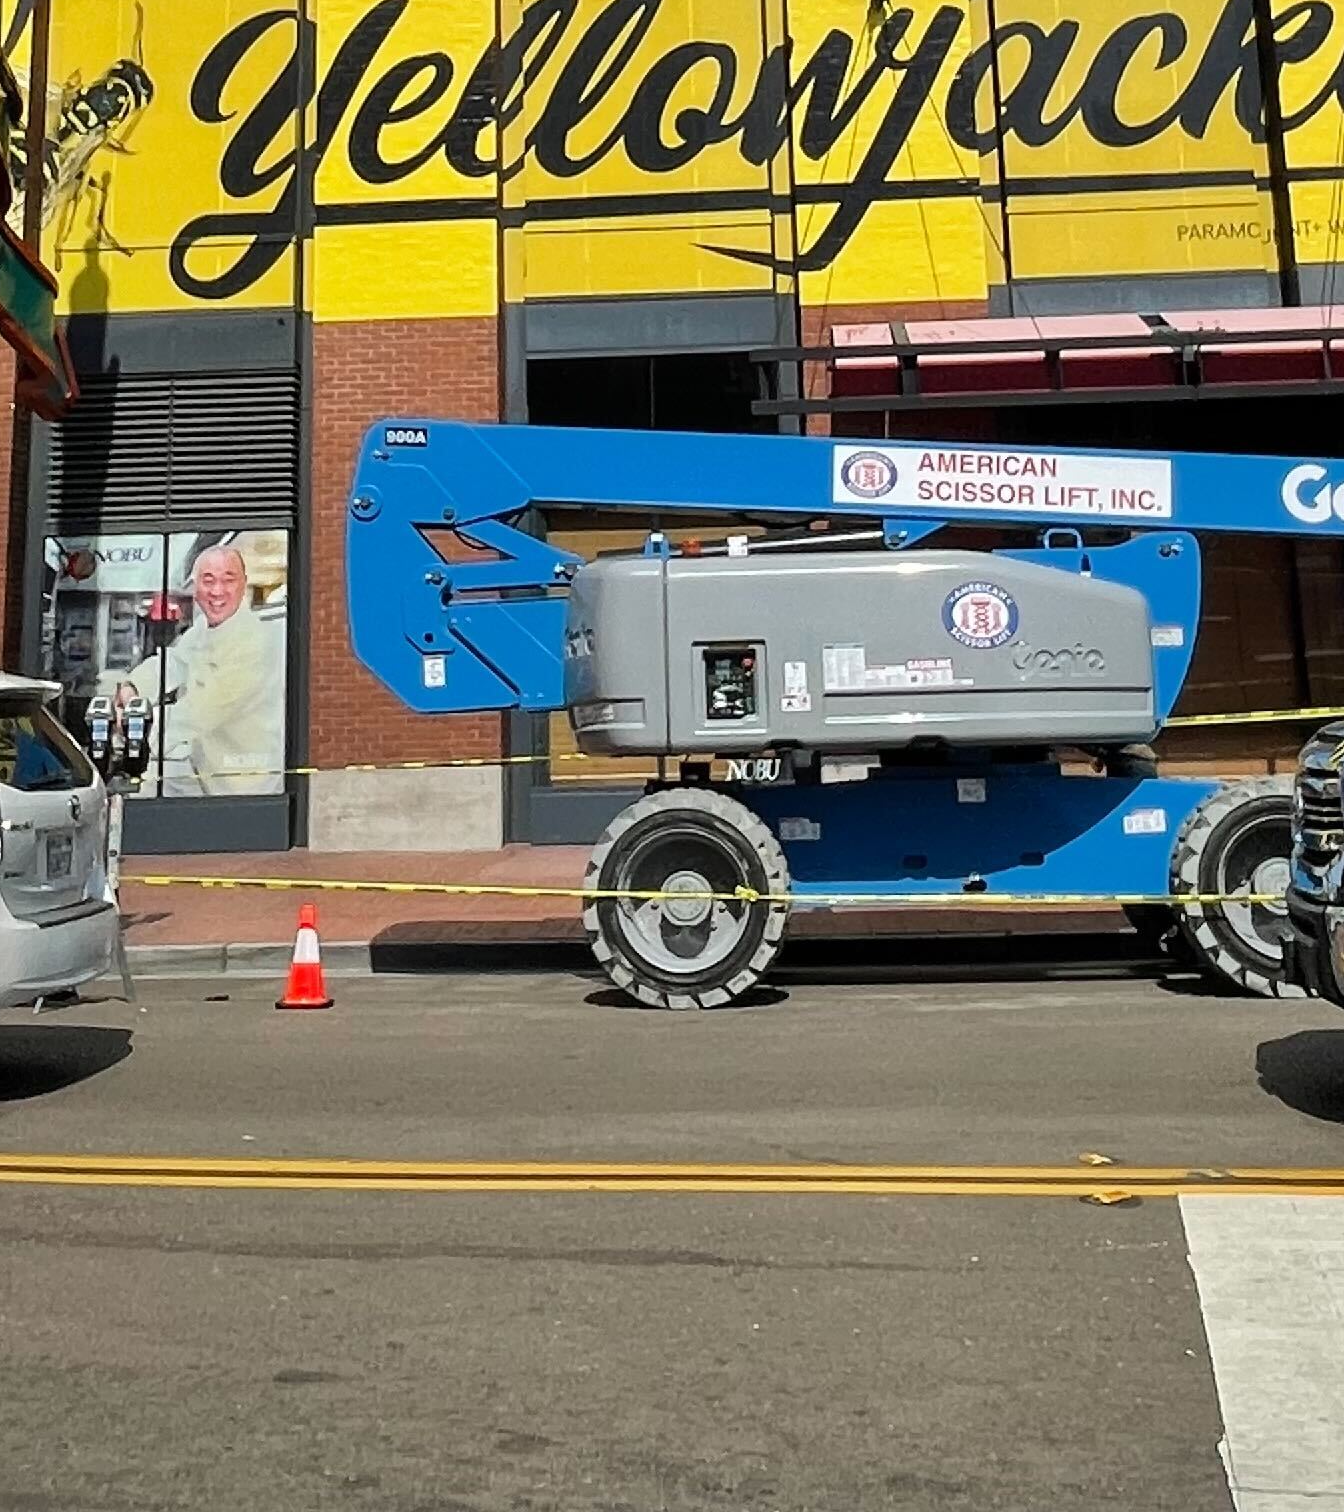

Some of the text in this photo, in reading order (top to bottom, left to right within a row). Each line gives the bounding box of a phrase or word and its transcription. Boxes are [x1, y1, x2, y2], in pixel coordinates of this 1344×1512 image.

[1176, 218, 1322, 245] PARAMOT+
[386, 430, 427, 444] 900A
[918, 453, 1057, 478] AMERICAN
[917, 480, 1164, 513] SCISSOR LIFT, INC.
[94, 546, 154, 563] NOBU
[725, 757, 783, 782] NOBU
